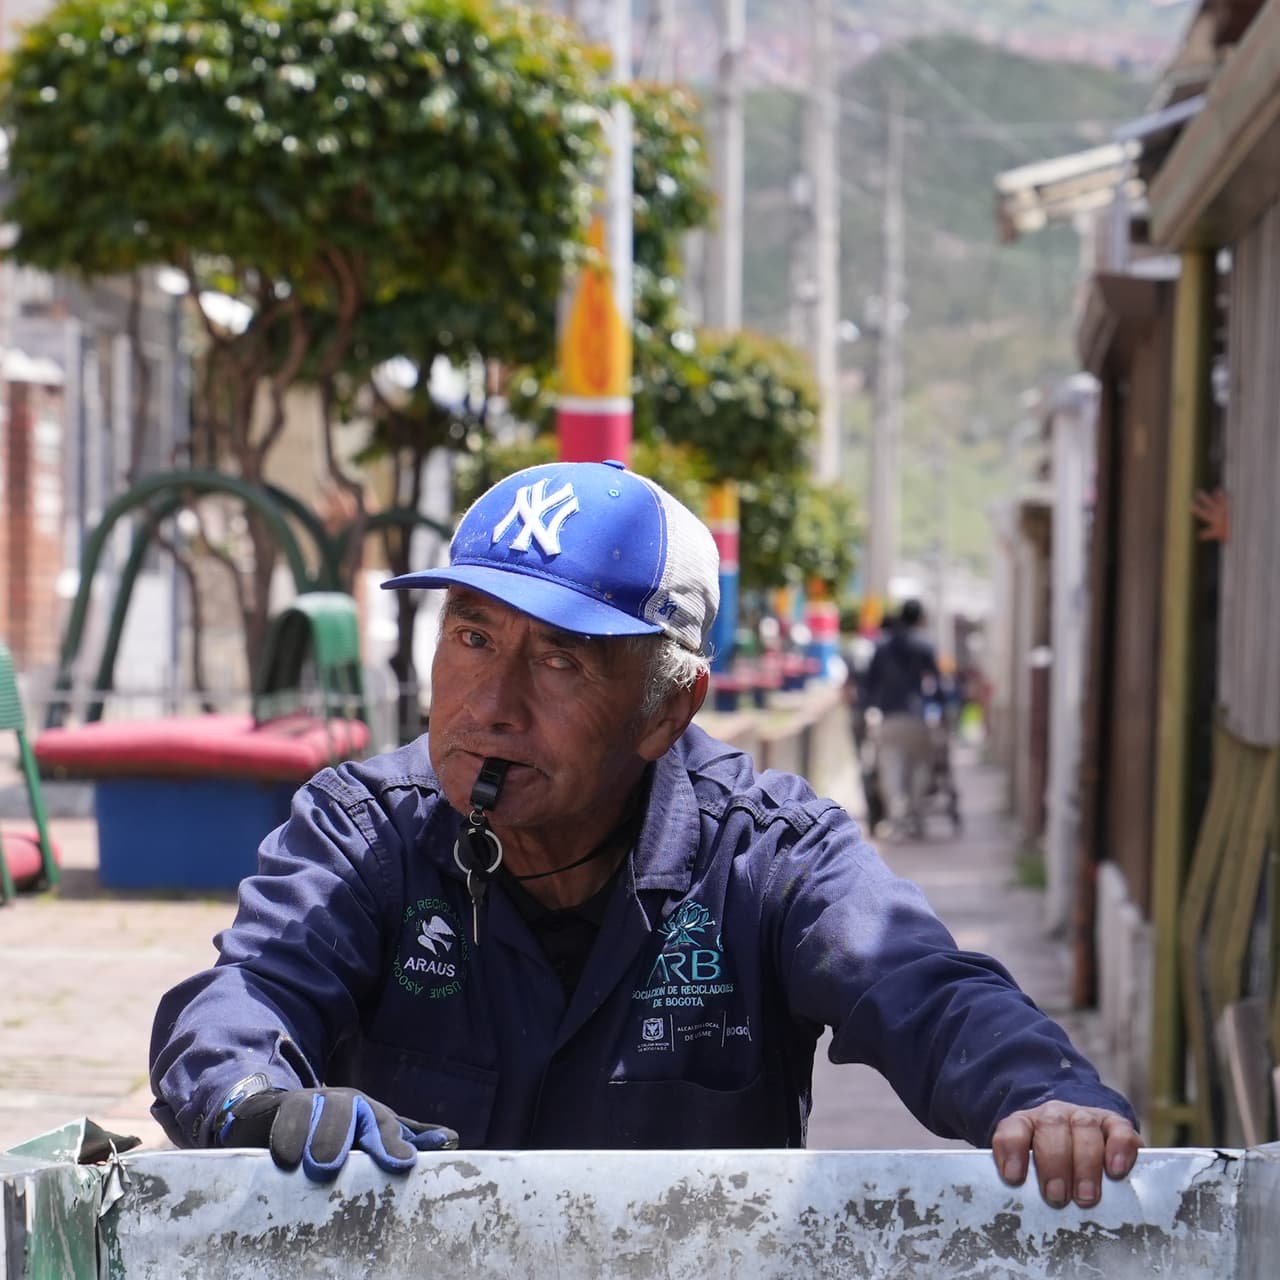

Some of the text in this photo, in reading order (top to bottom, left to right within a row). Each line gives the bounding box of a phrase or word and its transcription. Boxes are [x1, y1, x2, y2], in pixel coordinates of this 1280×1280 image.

[403, 957, 456, 977] ARAUS
[646, 949, 721, 987] ARB
[667, 985, 679, 995] DE
[653, 996, 704, 1008] DE BOGOTA
